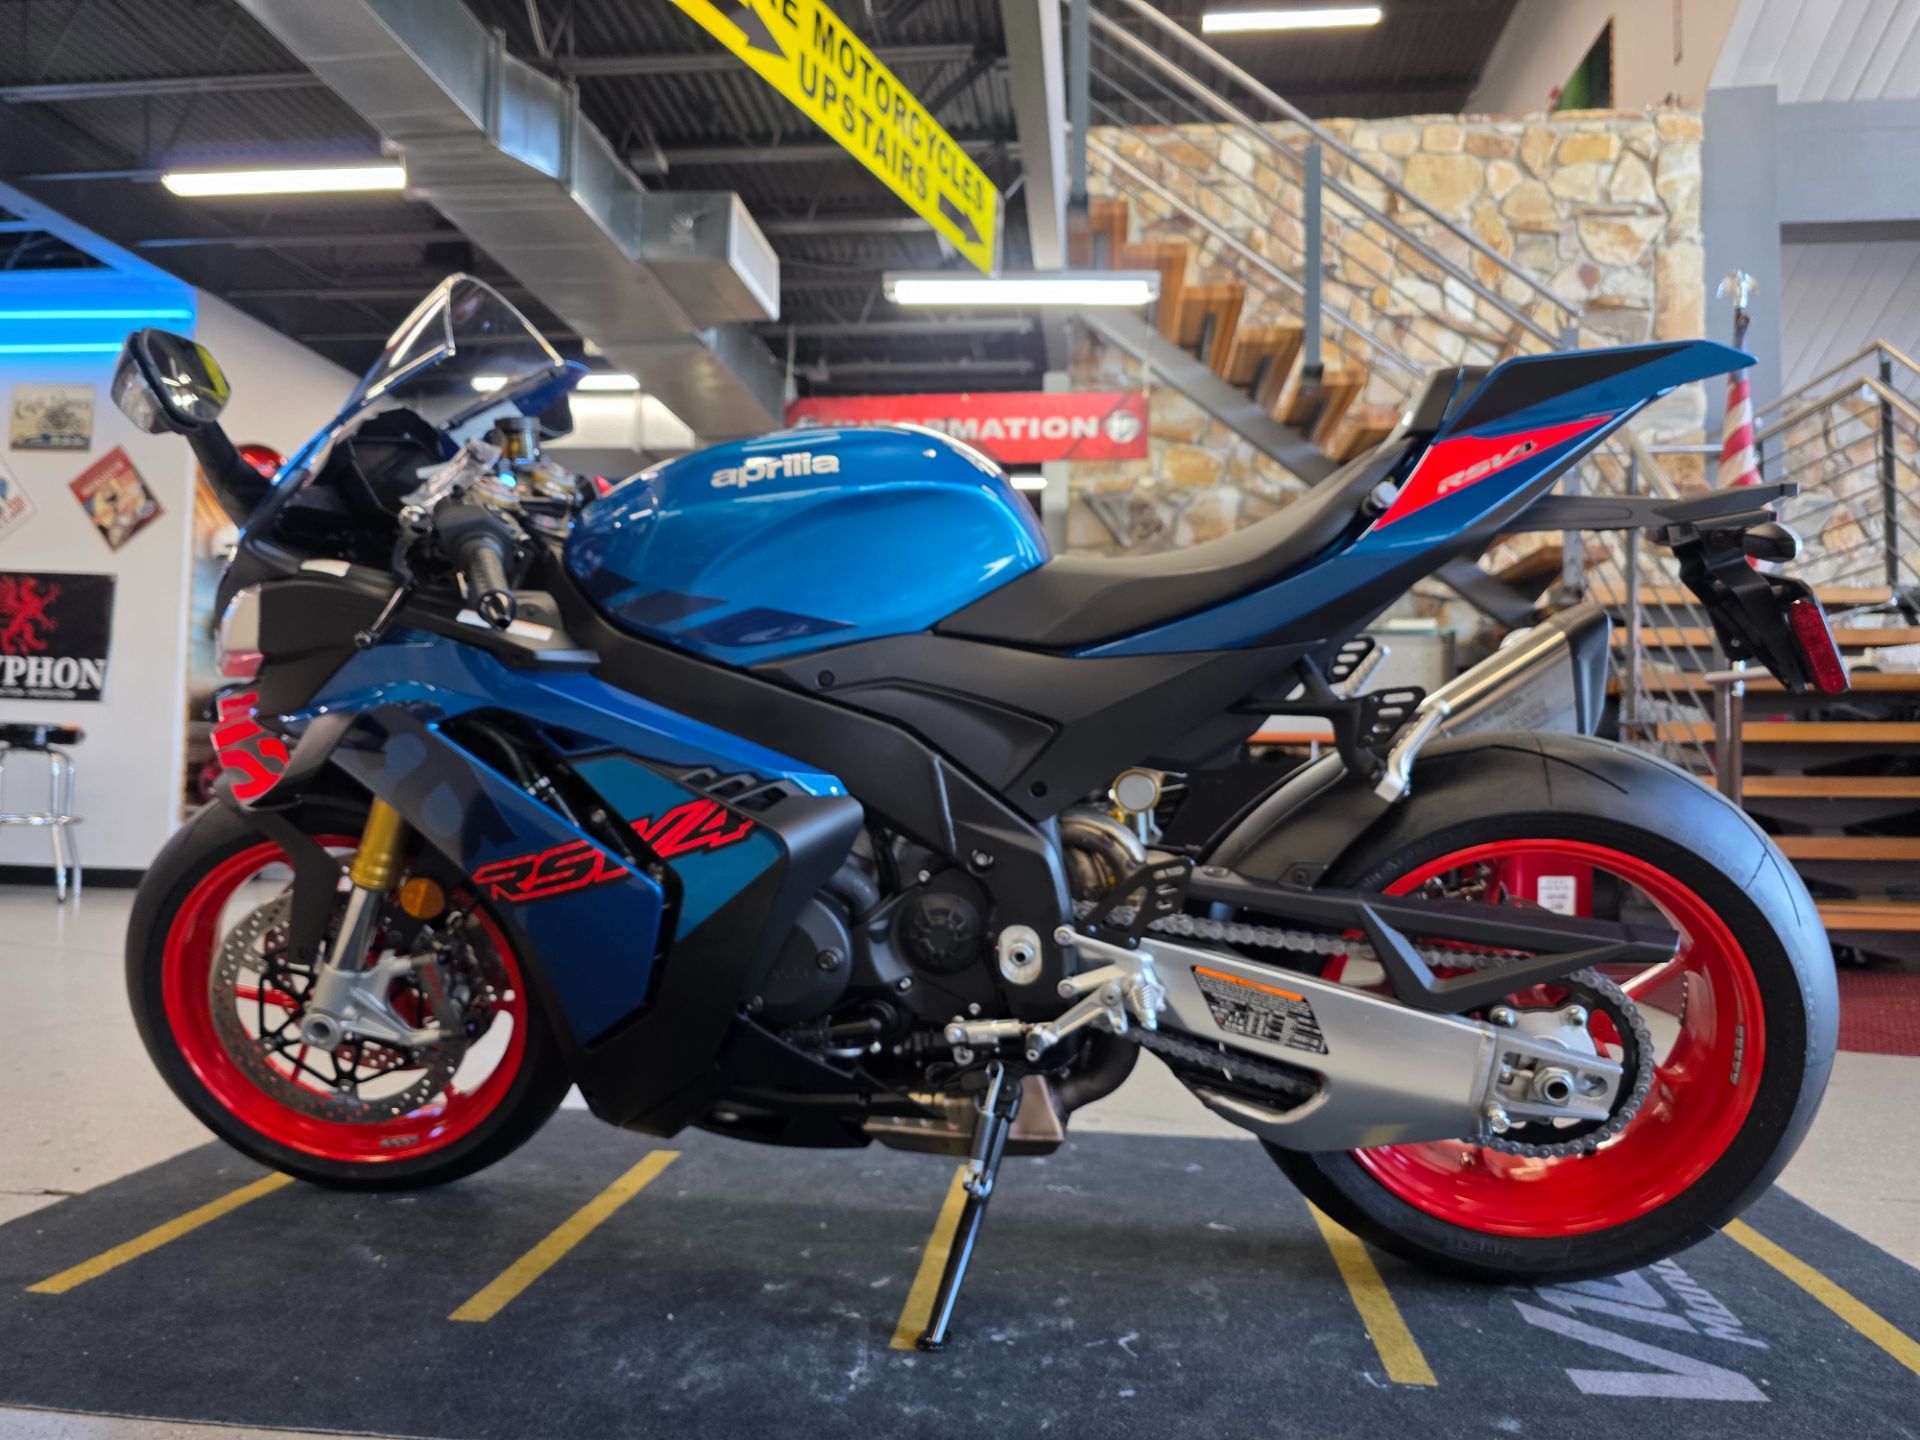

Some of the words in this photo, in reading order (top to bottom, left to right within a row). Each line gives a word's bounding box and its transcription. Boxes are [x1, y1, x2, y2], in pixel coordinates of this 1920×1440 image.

[799, 51, 929, 202] UPSTAIRS
[813, 10, 986, 212] MOTORCYCLES
[710, 452, 841, 489] aprilia
[0, 655, 107, 690] PHON
